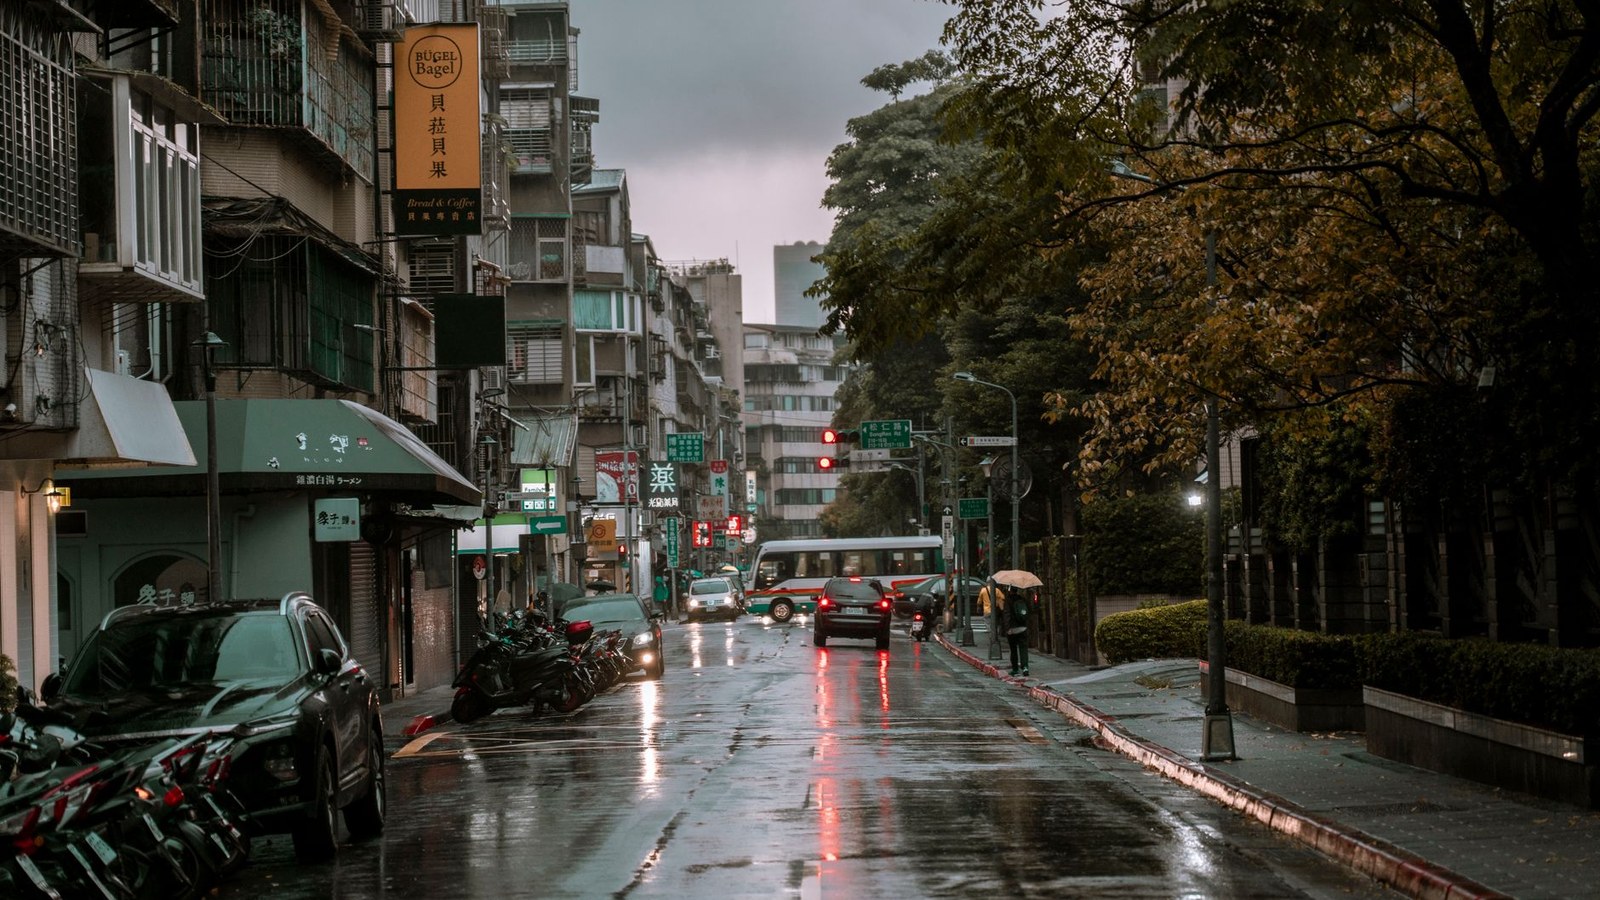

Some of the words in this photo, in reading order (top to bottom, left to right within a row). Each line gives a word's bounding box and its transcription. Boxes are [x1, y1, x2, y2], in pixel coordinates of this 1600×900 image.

[415, 50, 457, 62] BÜGEL
[415, 61, 454, 79] Bagel
[428, 94, 448, 178] 貝菈貝果
[407, 199, 435, 208] Bread
[436, 200, 445, 208] &
[447, 198, 475, 210] Coffee
[869, 422, 902, 431] 松仁路
